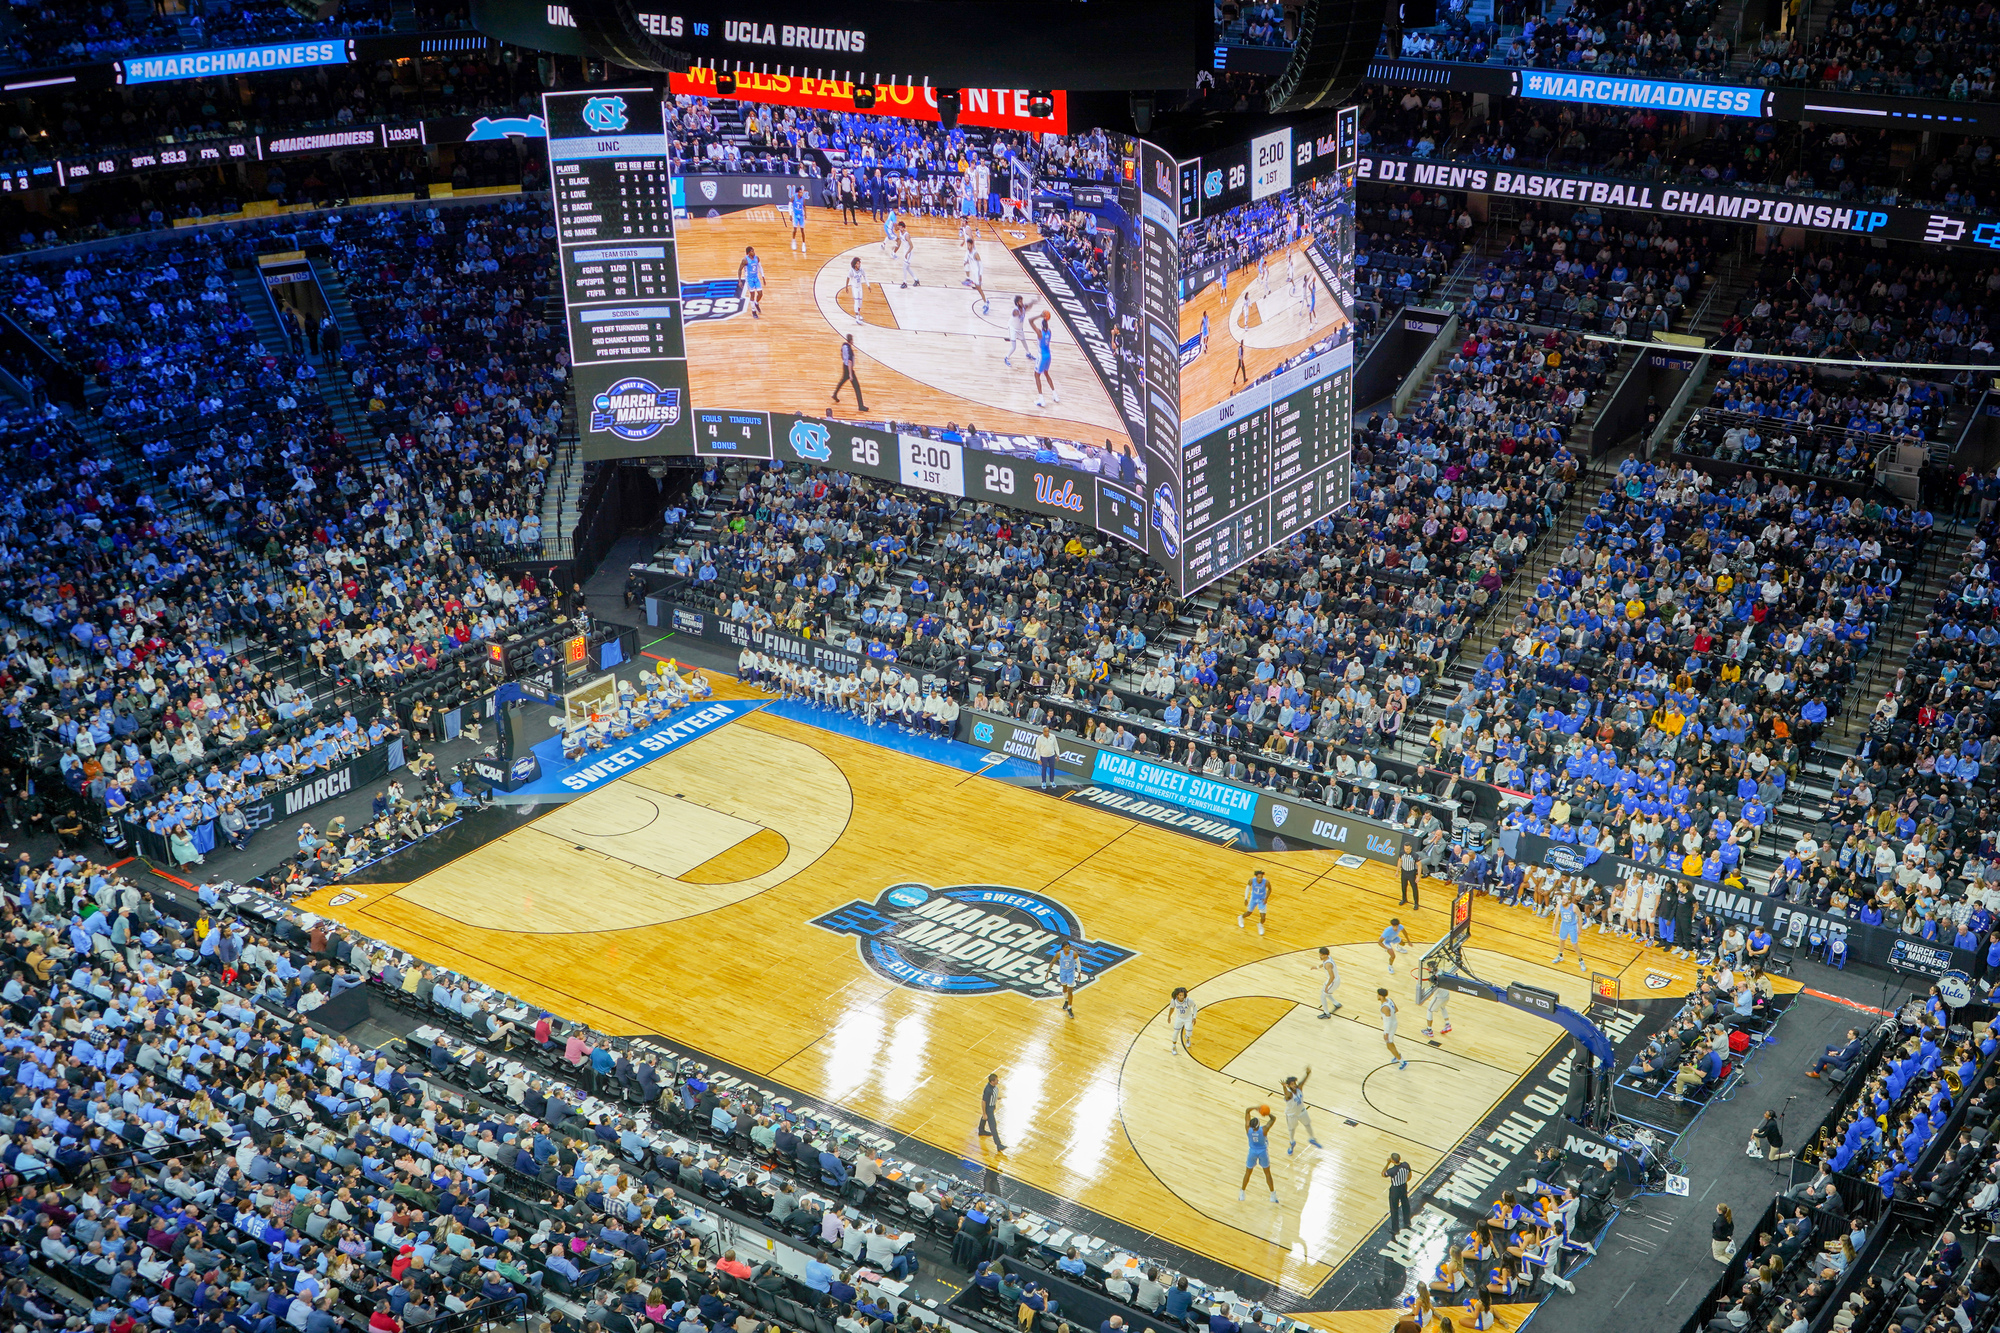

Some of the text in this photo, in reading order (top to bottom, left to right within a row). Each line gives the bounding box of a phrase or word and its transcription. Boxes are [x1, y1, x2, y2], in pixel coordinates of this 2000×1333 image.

[693, 20, 866, 52] VS UCLA BRUINS
[130, 44, 334, 78] #MARCHMADNESS
[1528, 75, 1750, 112] #MARCHMADNESS
[388, 127, 419, 141] 10:34
[1347, 124, 1352, 135] 4
[269, 131, 375, 153] #MARCHMADNESS
[597, 141, 620, 152] UNC
[1259, 141, 1284, 167] 2:00
[1347, 147, 1352, 158] 3
[70, 145, 245, 177] FG% 48 3PT% 33.3 FT% 50
[556, 161, 656, 174] PLAYER PTS REB AST
[1229, 164, 1245, 190] 26
[1297, 141, 1312, 166] 29
[3, 178, 29, 192] 4 3
[569, 177, 590, 186] BLACK
[1184, 179, 1190, 191] 4
[1266, 170, 1278, 185] 1ST
[570, 190, 587, 199] LOVE
[742, 183, 772, 199] UCLA
[1379, 160, 1407, 182] DI
[1413, 167, 1488, 190] MEN'S
[1494, 172, 1653, 209] BASKETBALL
[1660, 189, 1888, 233] CHAMPIONSHIP
[572, 203, 593, 211] BACOT
[1184, 204, 1190, 216] 4
[573, 215, 603, 224] JOHNSON
[574, 228, 598, 237] MANEK
[582, 266, 604, 275] FG/FGA
[610, 264, 627, 273] 11/30
[1203, 269, 1215, 282] UCLA
[576, 278, 605, 287] 3PT/3PTA
[641, 275, 653, 283] BLK
[586, 288, 627, 298] FT/FTA 0/3
[612, 310, 640, 318] SCORING
[1022, 250, 1118, 375] THE ROAD TO THE FINAL
[592, 326, 604, 334] PTS
[615, 323, 649, 332] TURNOVERS
[1408, 320, 1423, 330] 102
[605, 336, 628, 344] CHANCE
[627, 335, 650, 343] POINTS
[620, 347, 631, 355] THE
[631, 346, 651, 354] BENCH
[1651, 356, 1693, 370] 101 12
[1304, 362, 1321, 380] UCLA
[609, 393, 656, 409] MARCH
[616, 406, 678, 422] MADNESS
[1219, 404, 1235, 421] UNC
[1274, 402, 1289, 416] PLAYER
[702, 415, 762, 425] FOULS TIMEOUTS
[708, 425, 751, 439] 4 4
[712, 441, 737, 450] BONUS
[1185, 445, 1202, 460] PLAYER
[911, 443, 951, 470] 2:00
[851, 436, 1084, 512] 26 29 Ucla
[923, 470, 941, 484] 1ST
[1103, 487, 1143, 513] TIMEOUTS FOULS
[1111, 501, 1140, 527] 4 3
[1122, 524, 1139, 540] BONUS
[679, 610, 695, 622] MARCH
[681, 617, 703, 629] MADNESS
[718, 620, 858, 678] THE FINAL FOUR
[731, 636, 748, 647] TO THE
[1011, 728, 1039, 746] NORT
[562, 747, 644, 790] SWEET
[640, 703, 735, 752] SIXTEEN
[1060, 750, 1087, 764] ACC
[474, 761, 505, 783] NCAA
[1098, 753, 1252, 811] NCAA SWEET SIXTEEN
[285, 768, 351, 815] MARCH
[1113, 776, 1230, 816] HOSTED BY UNIVERSITY OF PENNSYLVANIA
[1074, 786, 1241, 841] PHILADELPHIA
[1312, 819, 1396, 857] UCLA Ucla
[1554, 850, 1574, 861] MARCH
[1557, 857, 1584, 871] MADNESS
[1616, 862, 1645, 879] THE
[1692, 884, 1765, 927] FINAL
[891, 892, 1047, 916] NCAA SWEET 16
[912, 897, 1059, 953] MARCH
[1563, 914, 1572, 922] 45
[1904, 943, 1936, 958] MARCH
[1907, 951, 1948, 969] MADNESS
[888, 961, 944, 986] ELITE 8
[1644, 967, 1673, 978] HOSTED
[1457, 985, 1478, 997] SPALDING
[1941, 984, 1965, 1000] Ucla
[1525, 996, 1534, 1004] ON
[1524, 1085, 1568, 1116] TO
[1486, 1112, 1547, 1155] THE
[1564, 1135, 1619, 1163] NCAA
[1434, 1146, 1511, 1208] FINAL
[1520, 1211, 1537, 1224] Ucla
